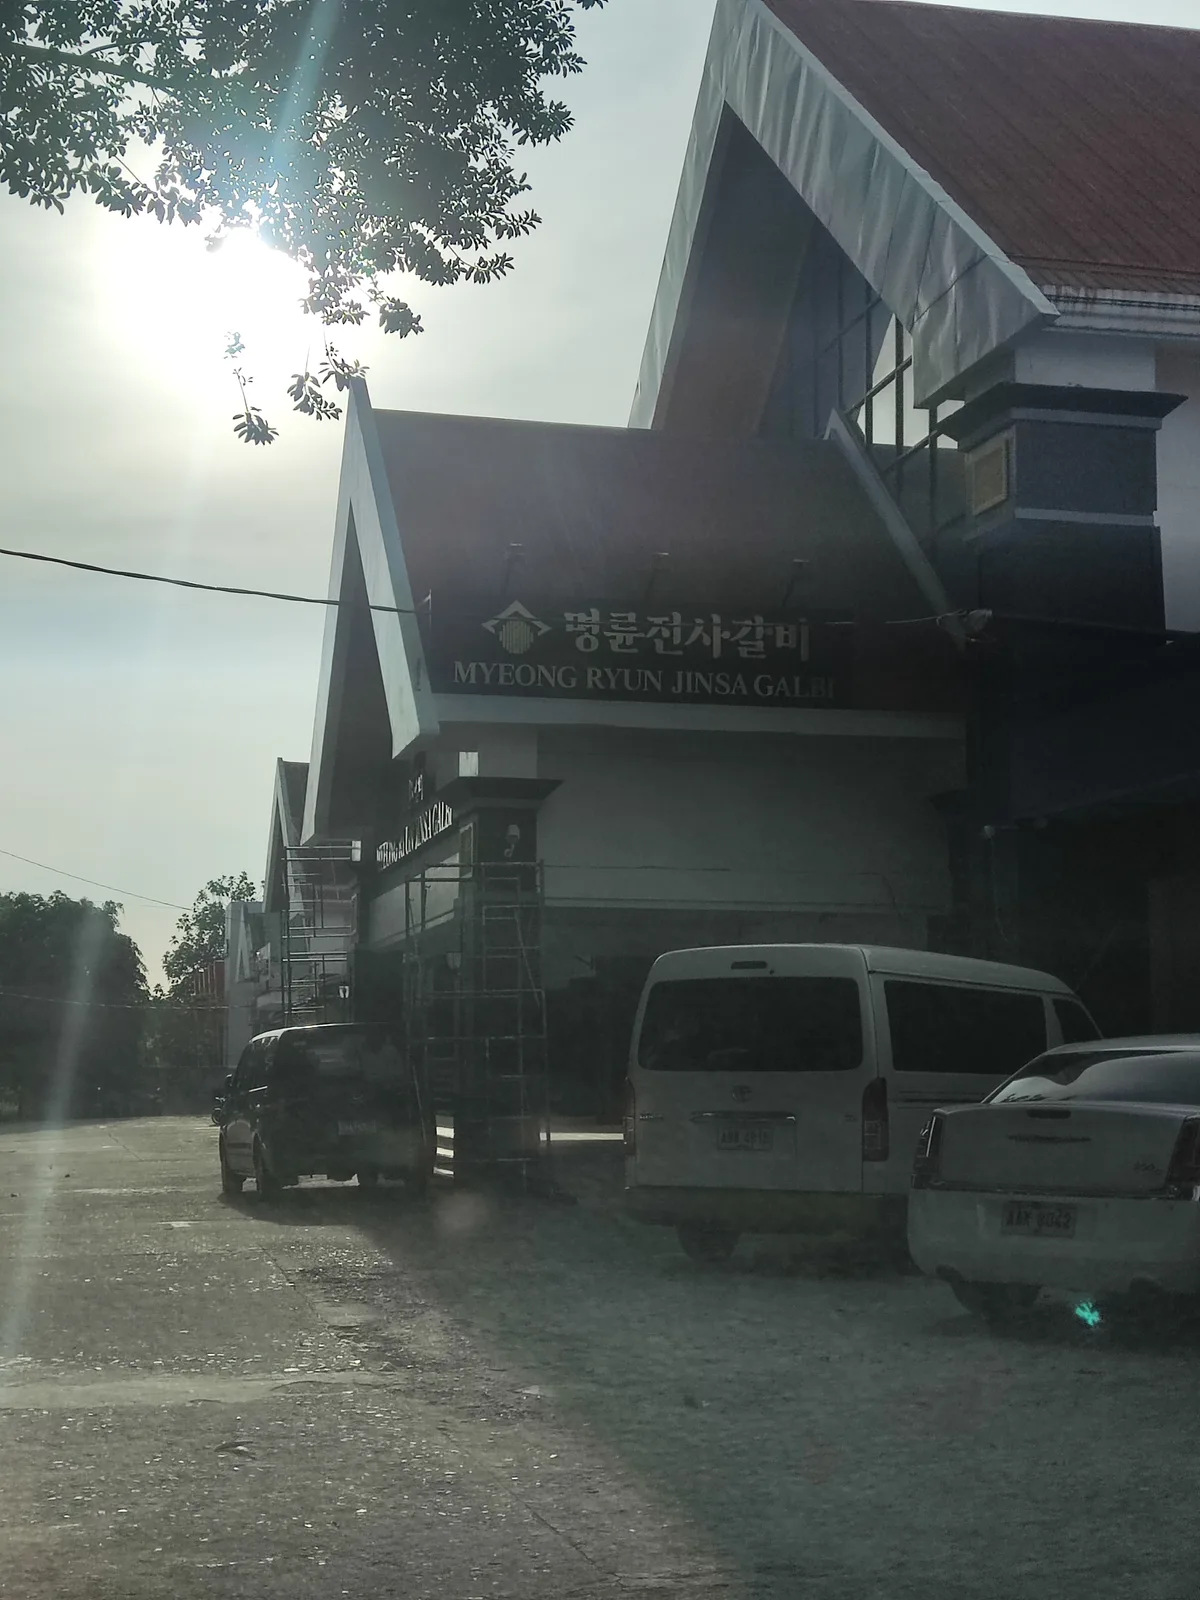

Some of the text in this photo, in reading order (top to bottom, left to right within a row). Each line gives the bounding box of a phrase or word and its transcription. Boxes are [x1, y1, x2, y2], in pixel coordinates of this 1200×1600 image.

[564, 608, 809, 662] 명륜진사갈비
[453, 660, 834, 699] MYEONG RYUN JINSA GALBI
